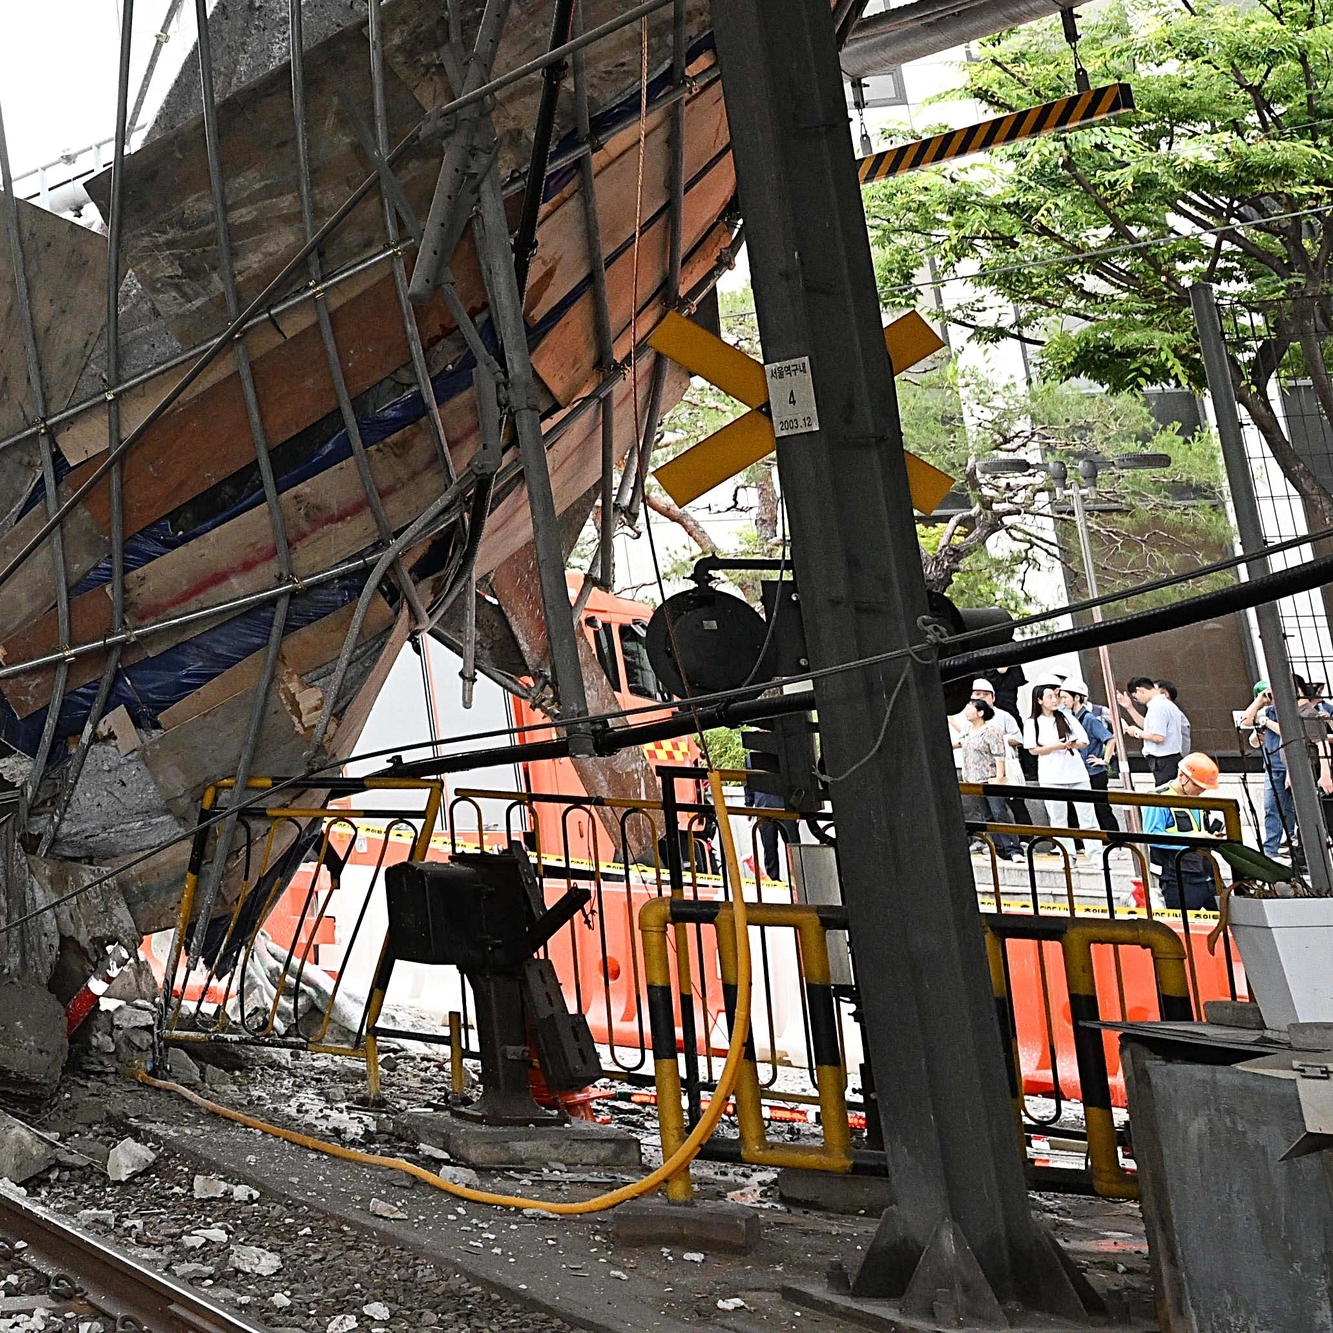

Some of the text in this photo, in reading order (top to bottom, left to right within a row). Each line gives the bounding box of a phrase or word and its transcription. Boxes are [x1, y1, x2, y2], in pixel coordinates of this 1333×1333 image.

[770, 362, 807, 380] 서울역구내
[788, 389, 796, 406] 4
[779, 416, 813, 431] 2003.12
